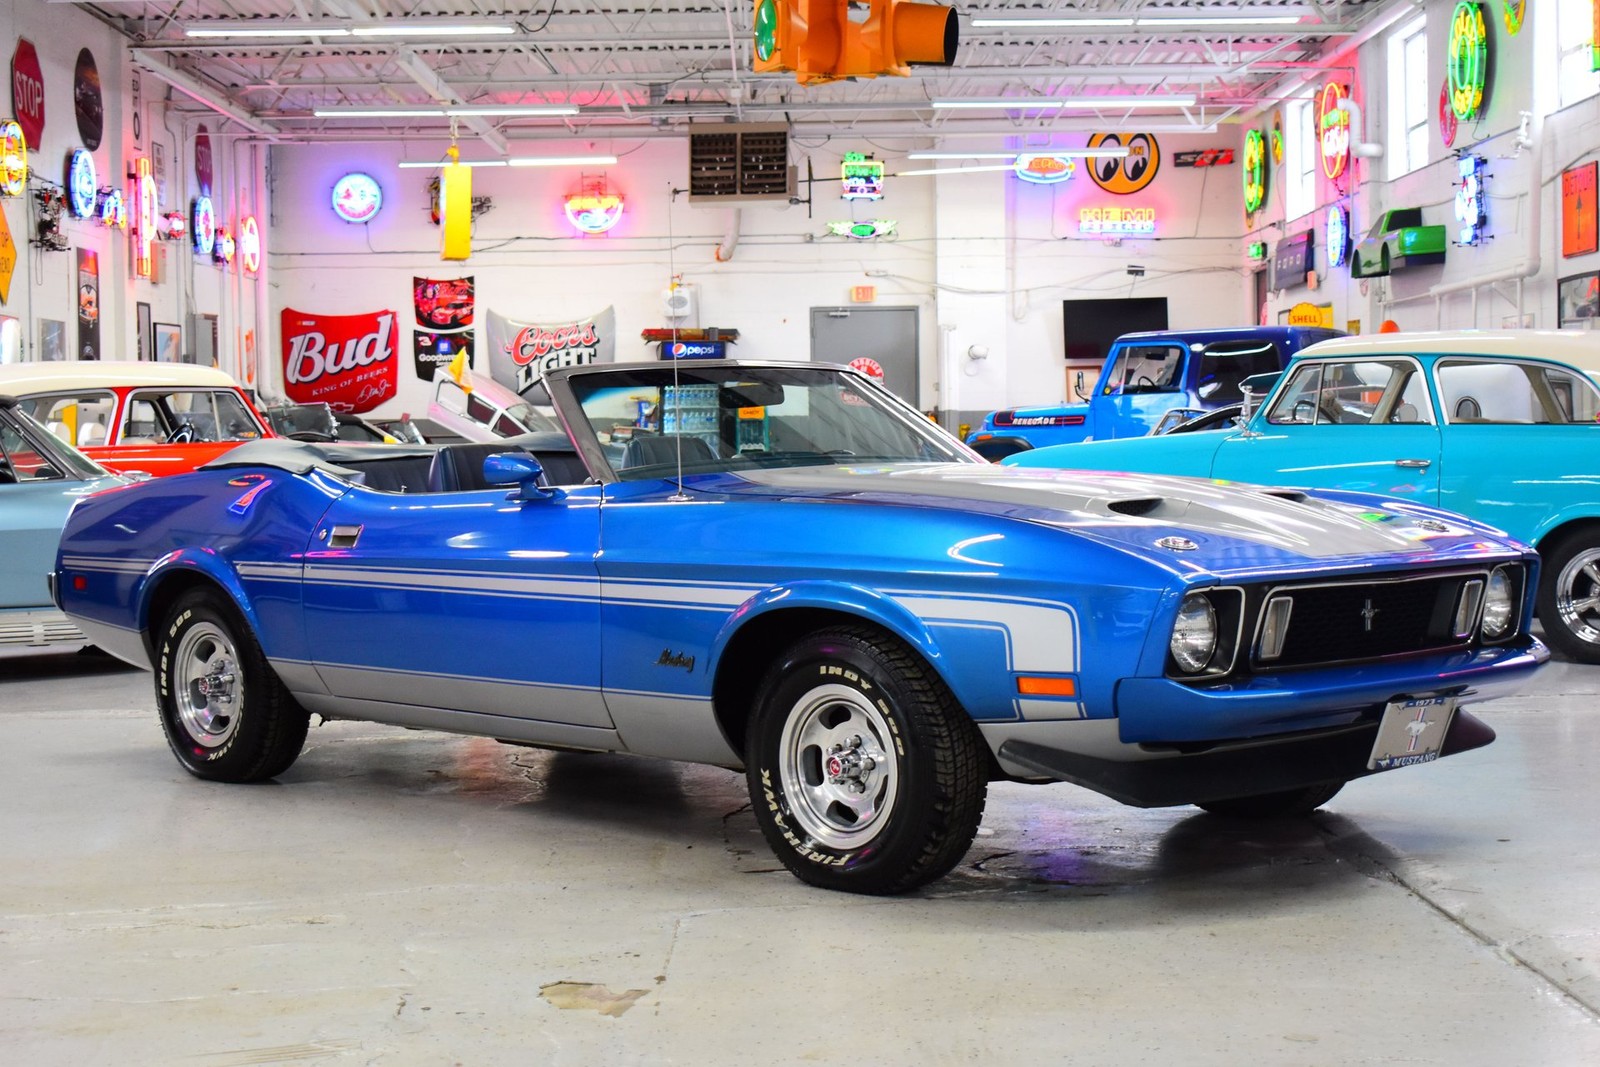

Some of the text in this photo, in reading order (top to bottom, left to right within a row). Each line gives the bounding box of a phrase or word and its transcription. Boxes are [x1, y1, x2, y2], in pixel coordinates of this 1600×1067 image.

[15, 70, 42, 119] STOP
[1080, 208, 1155, 222] HEMI
[1277, 254, 1301, 271] FORD
[856, 286, 874, 301] EXIT
[1292, 315, 1318, 324] SHELL
[286, 313, 393, 385] Bud
[504, 322, 600, 366] Coors
[687, 345, 715, 356] pepsi
[312, 366, 389, 396] KING OF BEERS
[516, 346, 596, 395] LIGHT
[1012, 416, 1056, 426] RENEGADE
[160, 609, 192, 696] INDY 500
[819, 665, 905, 757] INDY 500
[1415, 699, 1436, 708] 1973
[1391, 752, 1437, 768] MUSTANG
[760, 767, 851, 867] FIREHAWK
